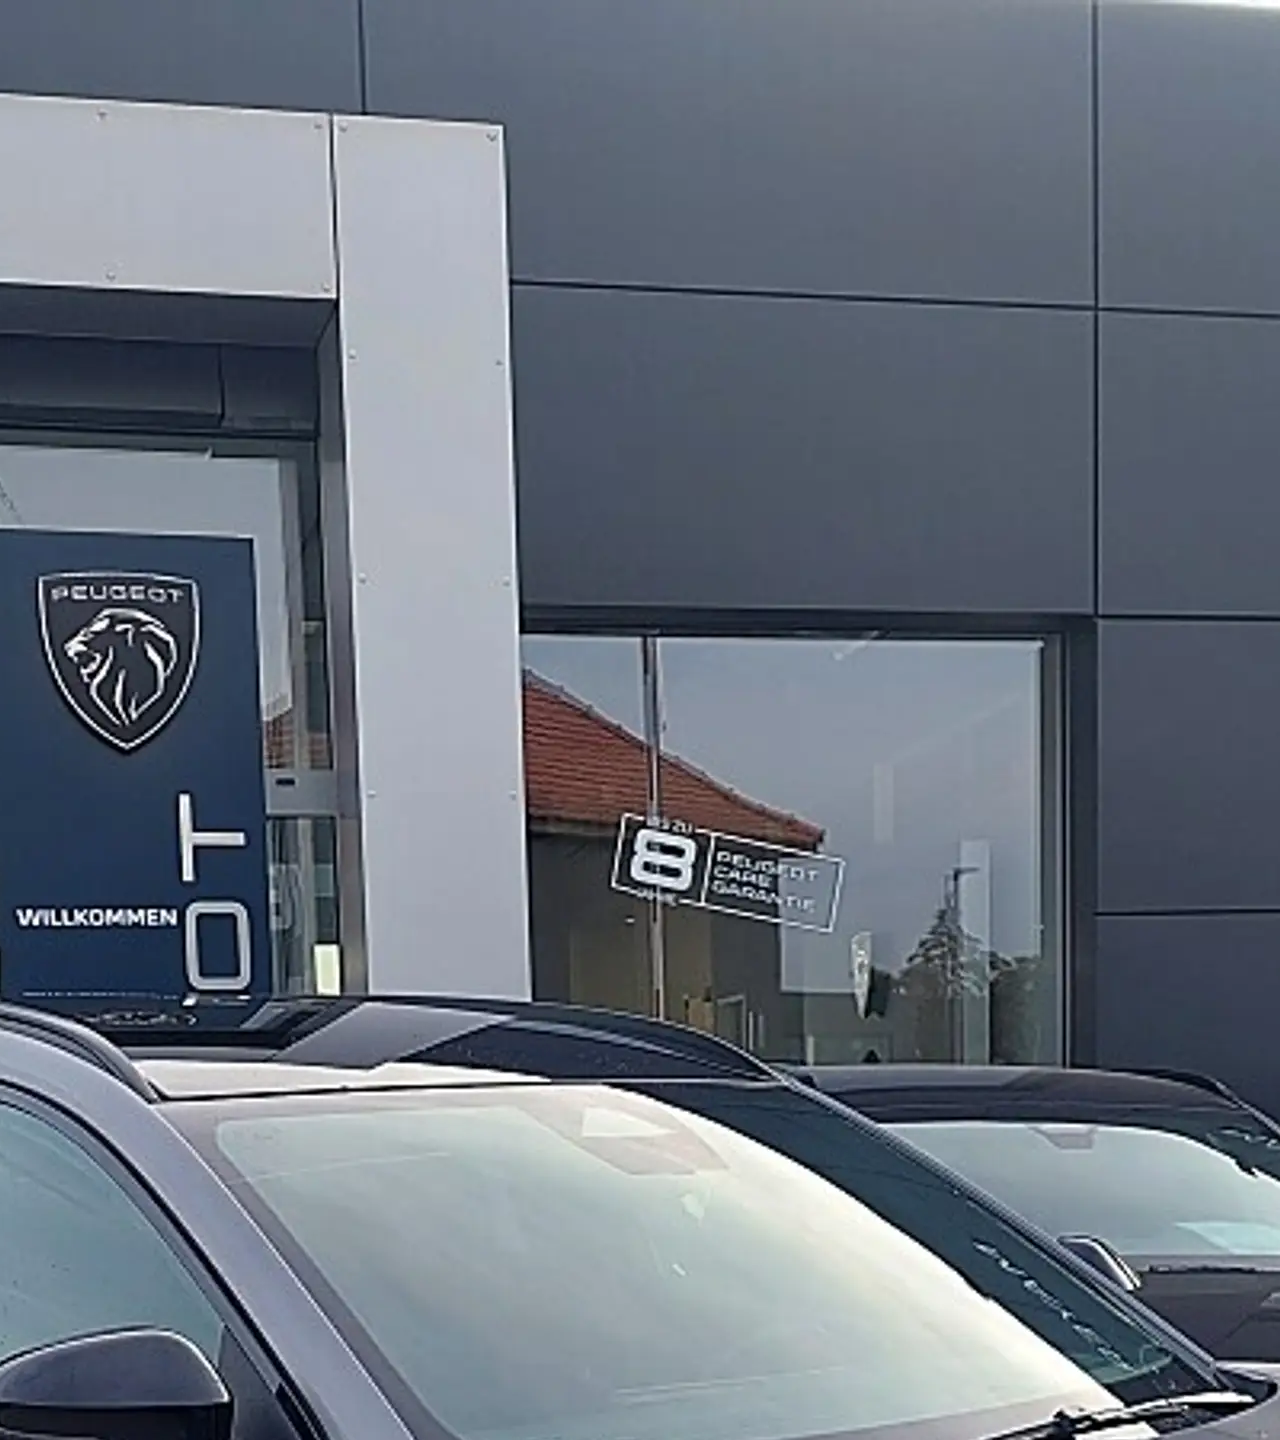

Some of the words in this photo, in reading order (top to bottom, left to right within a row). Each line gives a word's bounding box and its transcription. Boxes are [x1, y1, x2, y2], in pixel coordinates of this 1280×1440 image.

[51, 585, 184, 602] PEUGEOT
[630, 828, 696, 891] 8
[716, 851, 819, 882] PEUGEOT
[713, 865, 772, 888] CARE
[711, 879, 816, 914] GARANTIE
[16, 908, 178, 927] WILLKOMMEN
